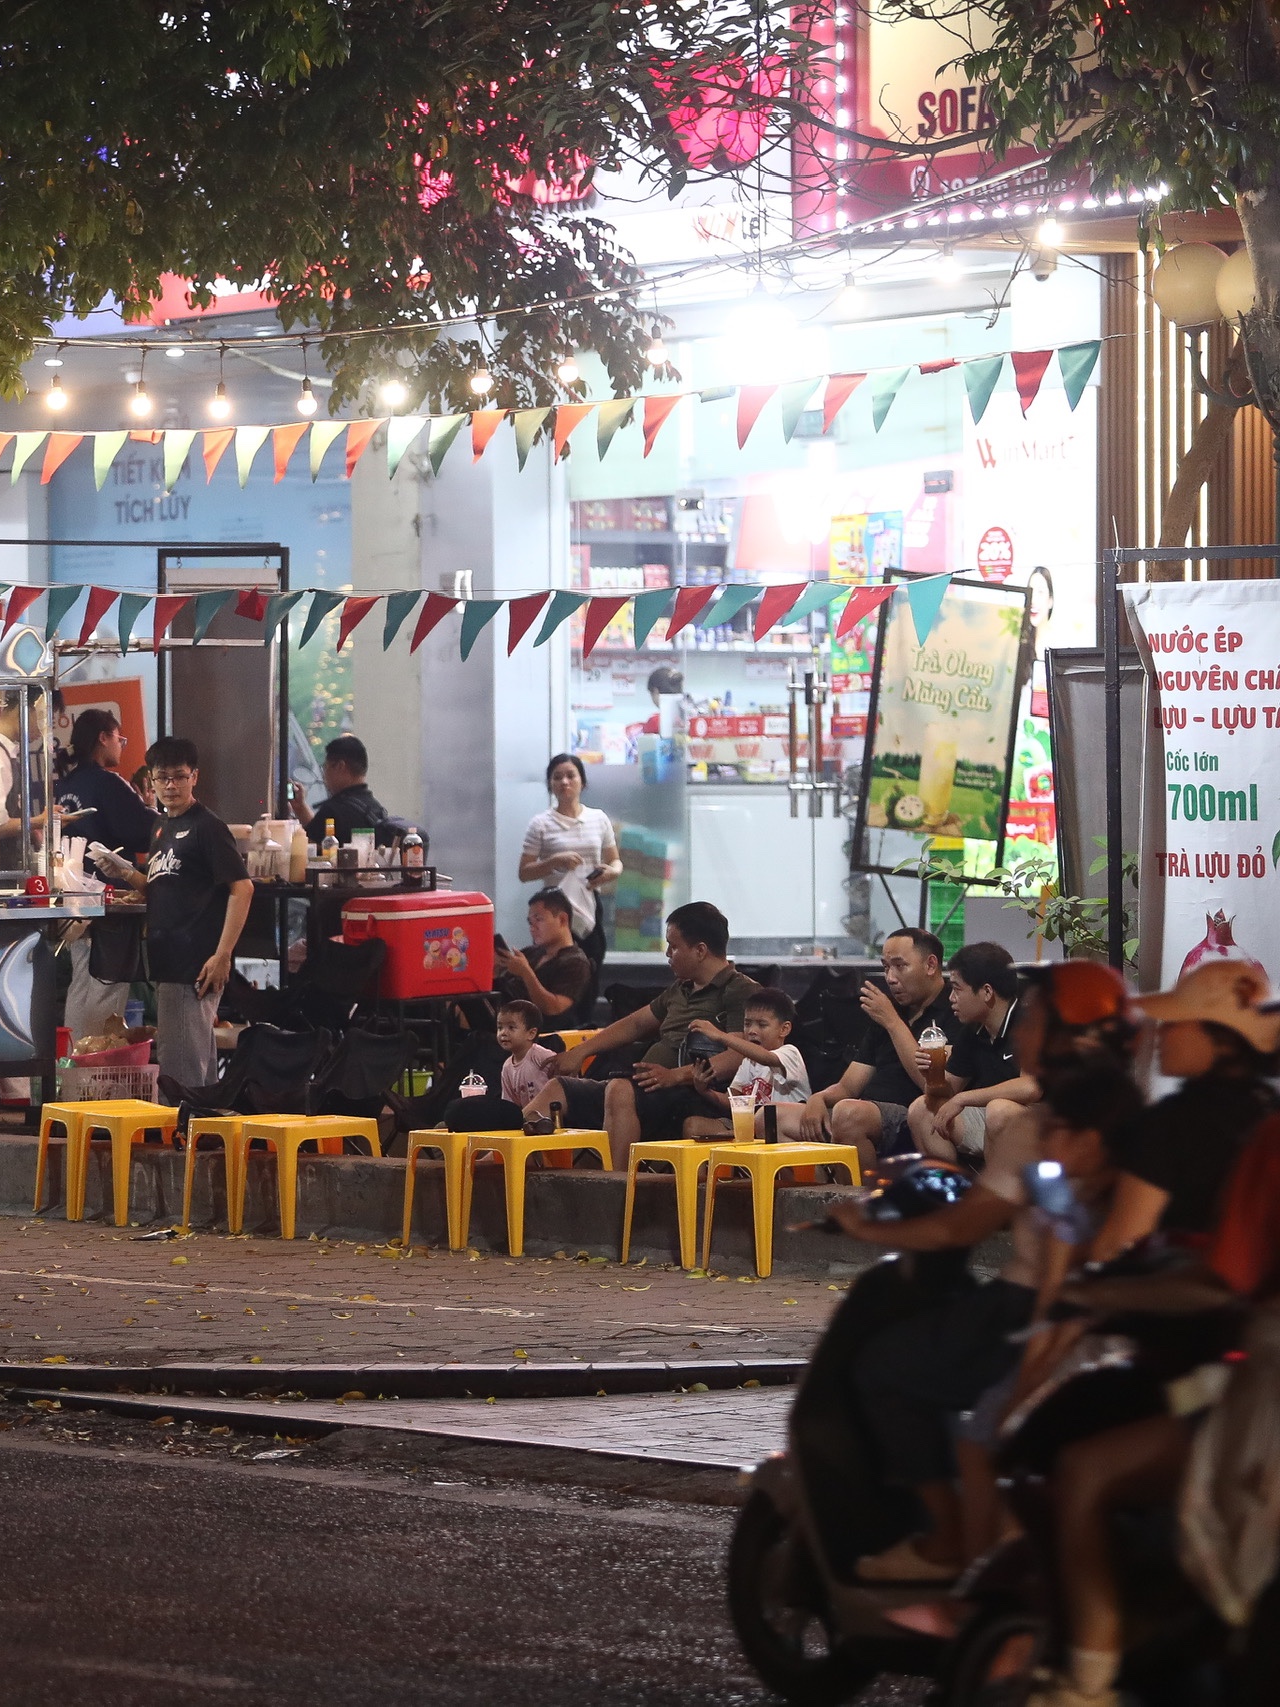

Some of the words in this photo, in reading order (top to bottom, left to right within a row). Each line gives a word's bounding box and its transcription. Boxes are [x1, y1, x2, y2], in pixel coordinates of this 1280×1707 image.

[918, 85, 996, 137] SOFA
[114, 494, 155, 524] TÍCH
[1148, 624, 1209, 653] NƯỚC
[1214, 625, 1243, 653] ÉP
[911, 646, 941, 674] Trà
[944, 649, 995, 687] Olong
[1153, 664, 1239, 691] NGUYÊN
[902, 676, 952, 714] Măng
[954, 685, 991, 713] Cầu
[1153, 704, 1187, 735] LỰU
[1212, 704, 1256, 735] LỰU
[1166, 748, 1190, 772] Cốc
[1194, 751, 1219, 772] lớn
[1167, 783, 1258, 822] 700ml
[1156, 849, 1190, 879] TRÀ
[1196, 850, 1231, 884] LỰU
[1237, 845, 1266, 879] ĐỎ
[34, 879, 45, 893] 3
